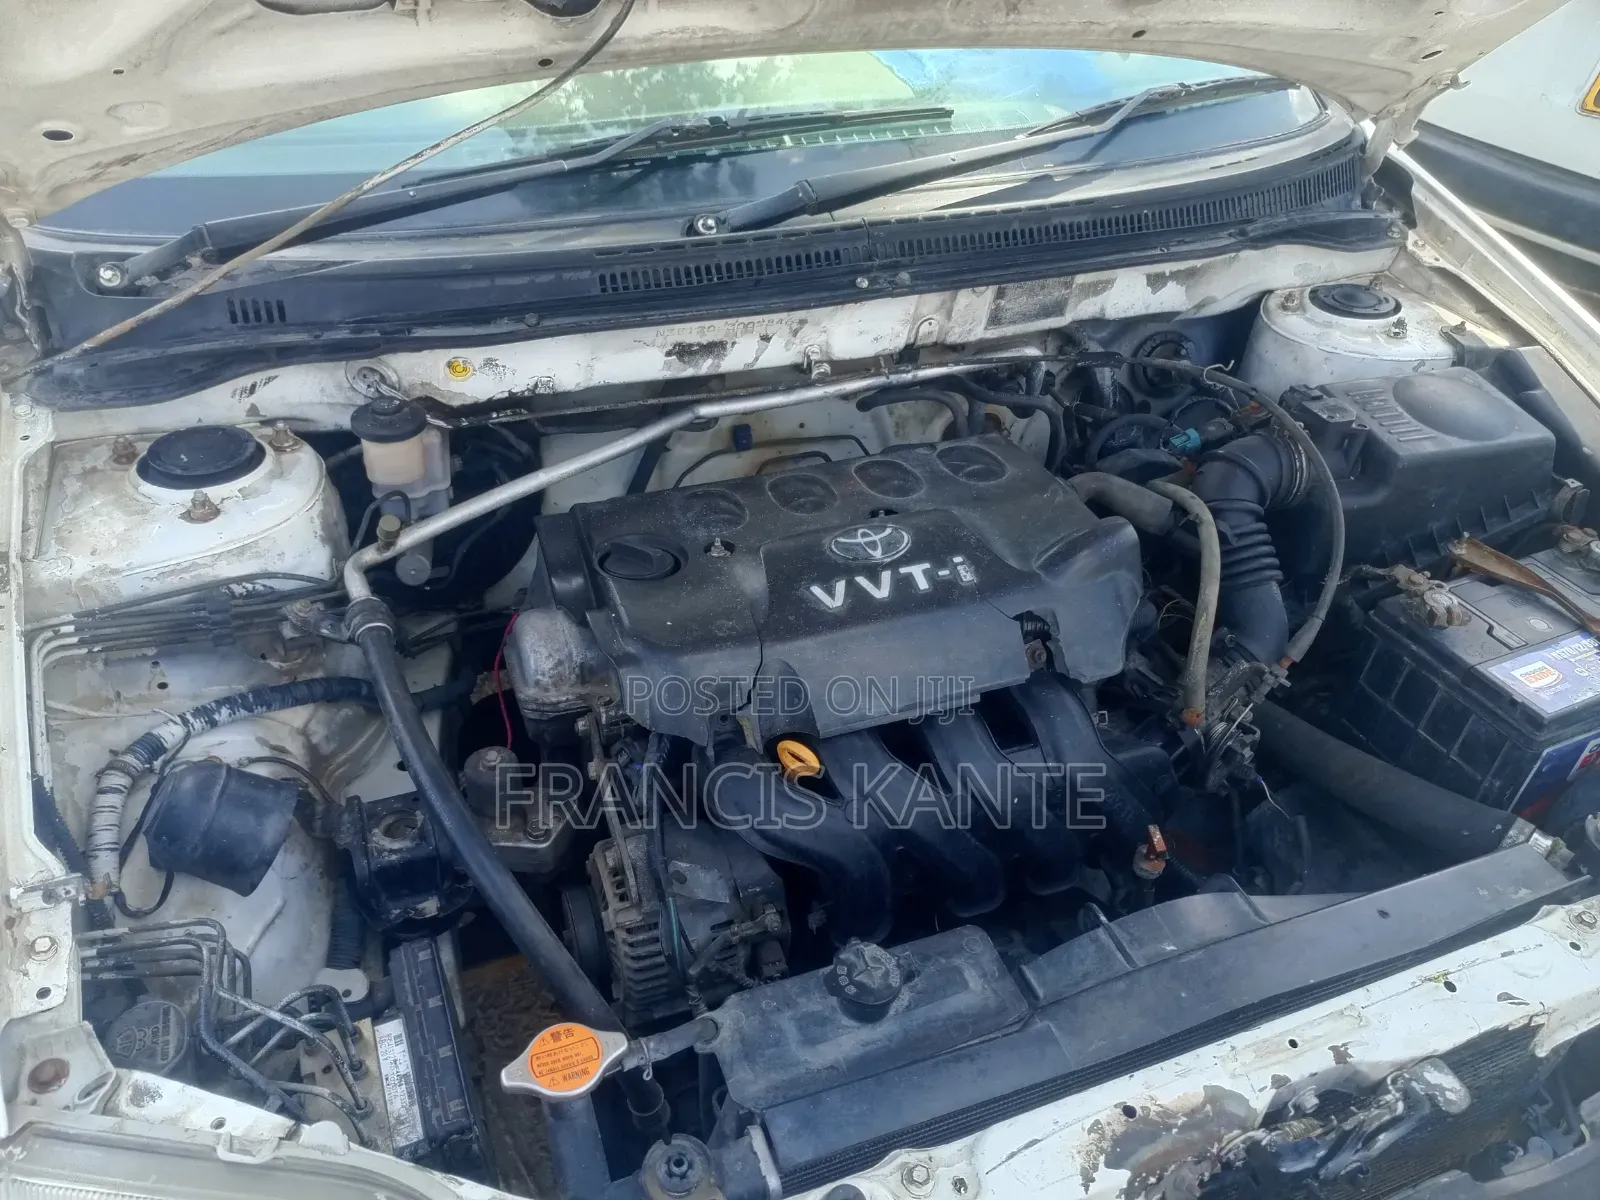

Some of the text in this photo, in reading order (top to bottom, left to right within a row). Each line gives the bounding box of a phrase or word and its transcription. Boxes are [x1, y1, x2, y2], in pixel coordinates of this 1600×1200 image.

[809, 556, 973, 609] VVT-i
[1523, 668, 1557, 684] EXIDE
[551, 1028, 575, 1043] 警告
[562, 1067, 590, 1082] WARNING
